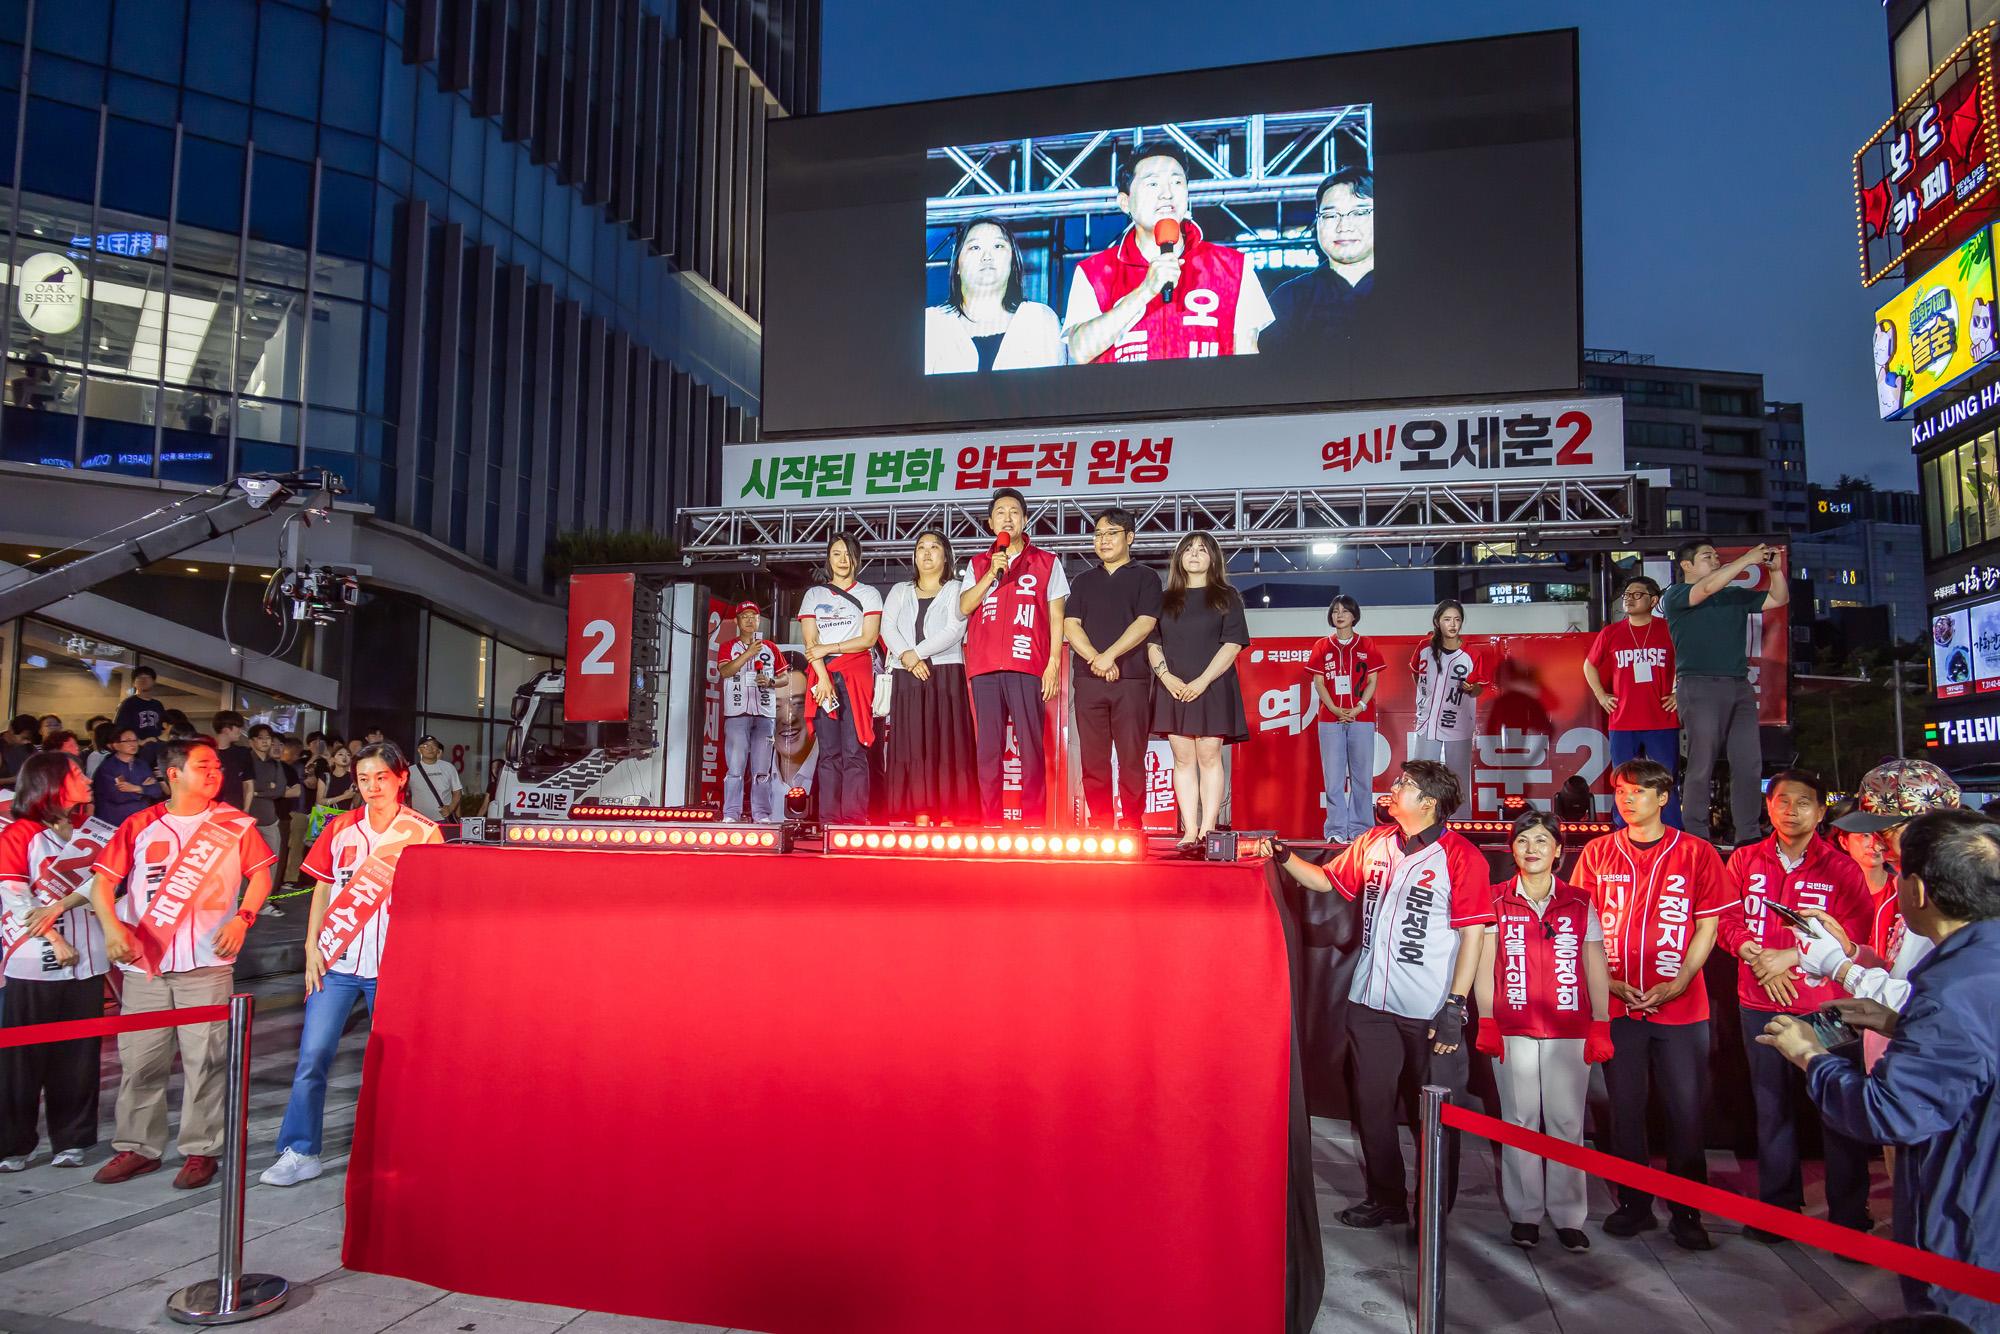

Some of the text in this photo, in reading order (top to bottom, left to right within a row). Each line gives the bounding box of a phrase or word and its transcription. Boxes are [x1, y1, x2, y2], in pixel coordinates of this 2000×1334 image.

[1890, 106, 1939, 183] 보드
[1894, 161, 1949, 233] 카페
[1956, 163, 1986, 192] DEVIL DICE
[24, 293, 76, 303] BERRY
[34, 283, 66, 293] OAK
[1910, 291, 1948, 330] 만화카페
[1912, 316, 1953, 374] 놀숲
[1911, 417, 1936, 446] KAI
[1938, 395, 1980, 431] JUNG
[740, 453, 856, 499] 시작된
[866, 448, 945, 494] 변화
[955, 441, 1077, 490] 압도적
[1088, 437, 1173, 485] 완성
[1321, 424, 1397, 472] 역시!
[818, 620, 852, 629] California
[1012, 574, 1037, 660] 오세훈
[581, 619, 616, 675] 2
[1324, 661, 1336, 670] 국민
[1419, 659, 1428, 674] 2
[1615, 647, 1667, 669] UPRISE
[760, 653, 771, 706] 오훈
[1354, 661, 1368, 697] 2
[1441, 664, 1468, 728] 오세훈
[1939, 715, 2000, 745] 7-ELEV
[52, 838, 104, 888] 2
[372, 819, 425, 858] 2
[150, 839, 224, 928] 최종부
[201, 872, 227, 911] 2
[319, 875, 383, 962] 주수현
[1362, 869, 1384, 950] 서울시의원
[1504, 924, 1528, 1004] 서울시의원
